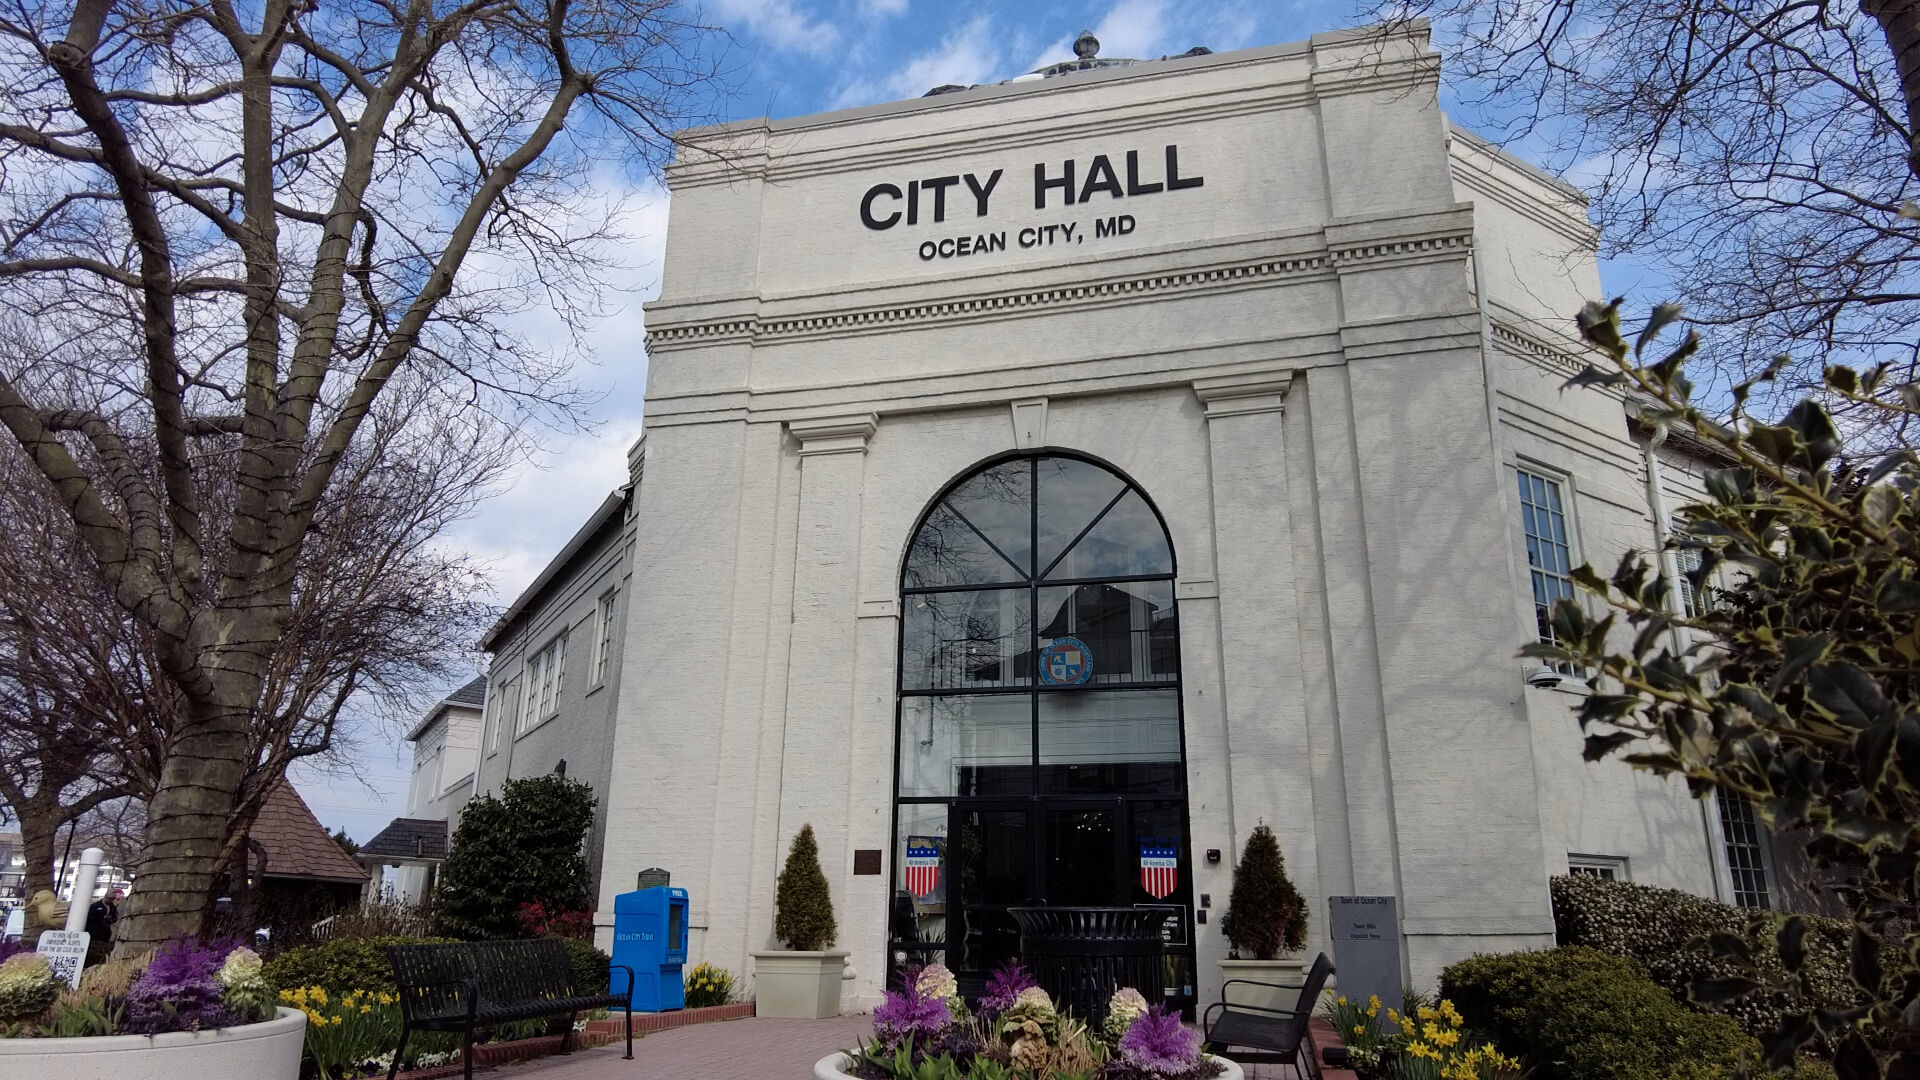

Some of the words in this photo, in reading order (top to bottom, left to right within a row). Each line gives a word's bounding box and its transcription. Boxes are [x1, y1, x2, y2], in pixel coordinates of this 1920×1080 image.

[860, 168, 1004, 231] CITY
[1034, 144, 1204, 209] HALL
[919, 231, 1006, 261] OCEAN
[1018, 222, 1084, 248] CITY,
[1095, 214, 1136, 238] MD
[1165, 860, 1175, 868] City
[1377, 897, 1388, 906] City
